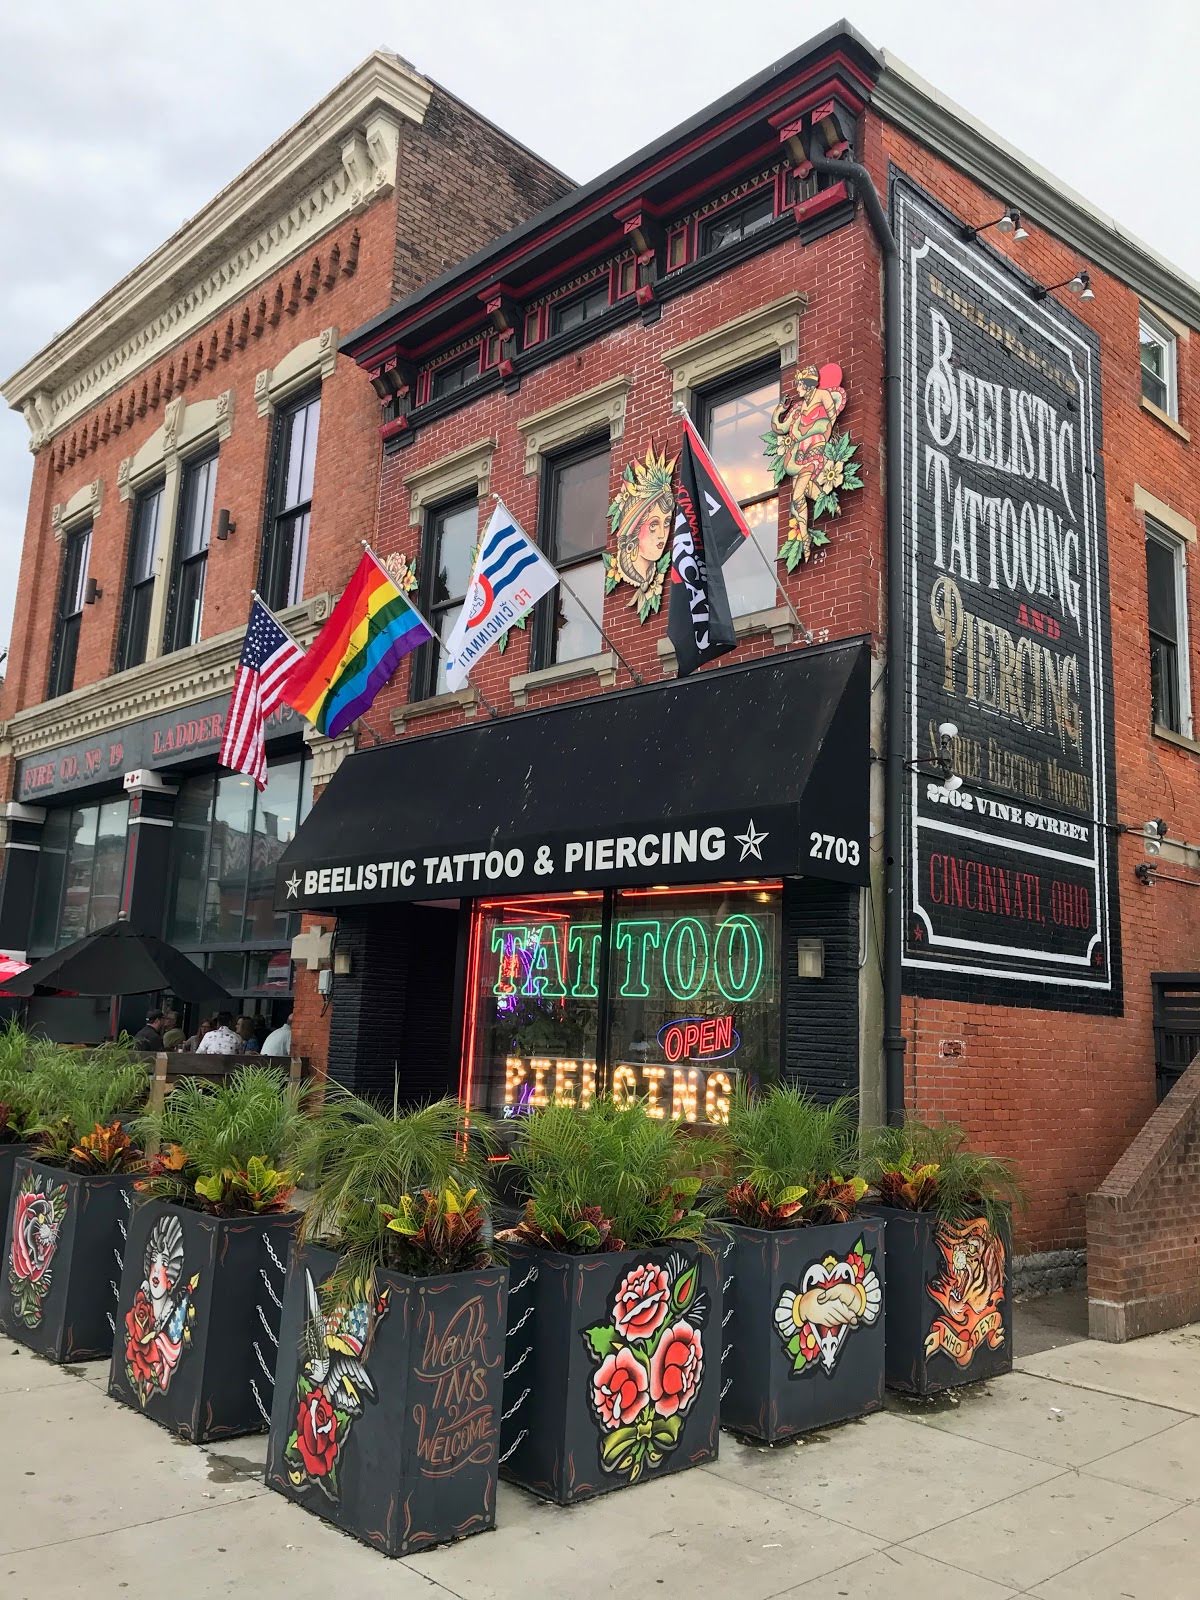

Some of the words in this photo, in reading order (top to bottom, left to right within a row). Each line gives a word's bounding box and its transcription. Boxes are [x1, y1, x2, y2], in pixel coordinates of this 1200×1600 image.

[925, 307, 1076, 523] BEELISTIC
[925, 444, 1083, 638] TATTOOING
[1016, 602, 1062, 640] AND
[930, 576, 1083, 757] PIERCING
[151, 712, 223, 755] LADDER
[24, 762, 55, 791] FIRE
[974, 796, 1022, 824] VINE
[1023, 811, 1089, 842] STREET
[303, 859, 417, 895] BEELISTIC
[423, 848, 525, 884] TATTOO
[533, 845, 555, 876] &
[564, 826, 726, 873] PIERCING
[809, 832, 861, 866] 2703
[929, 853, 1046, 928] CINCINNATI,
[1052, 880, 1090, 929] OHIO
[491, 914, 763, 1002] TATTOO
[664, 1016, 734, 1062] OPEN
[943, 1327, 962, 1354] WHO
